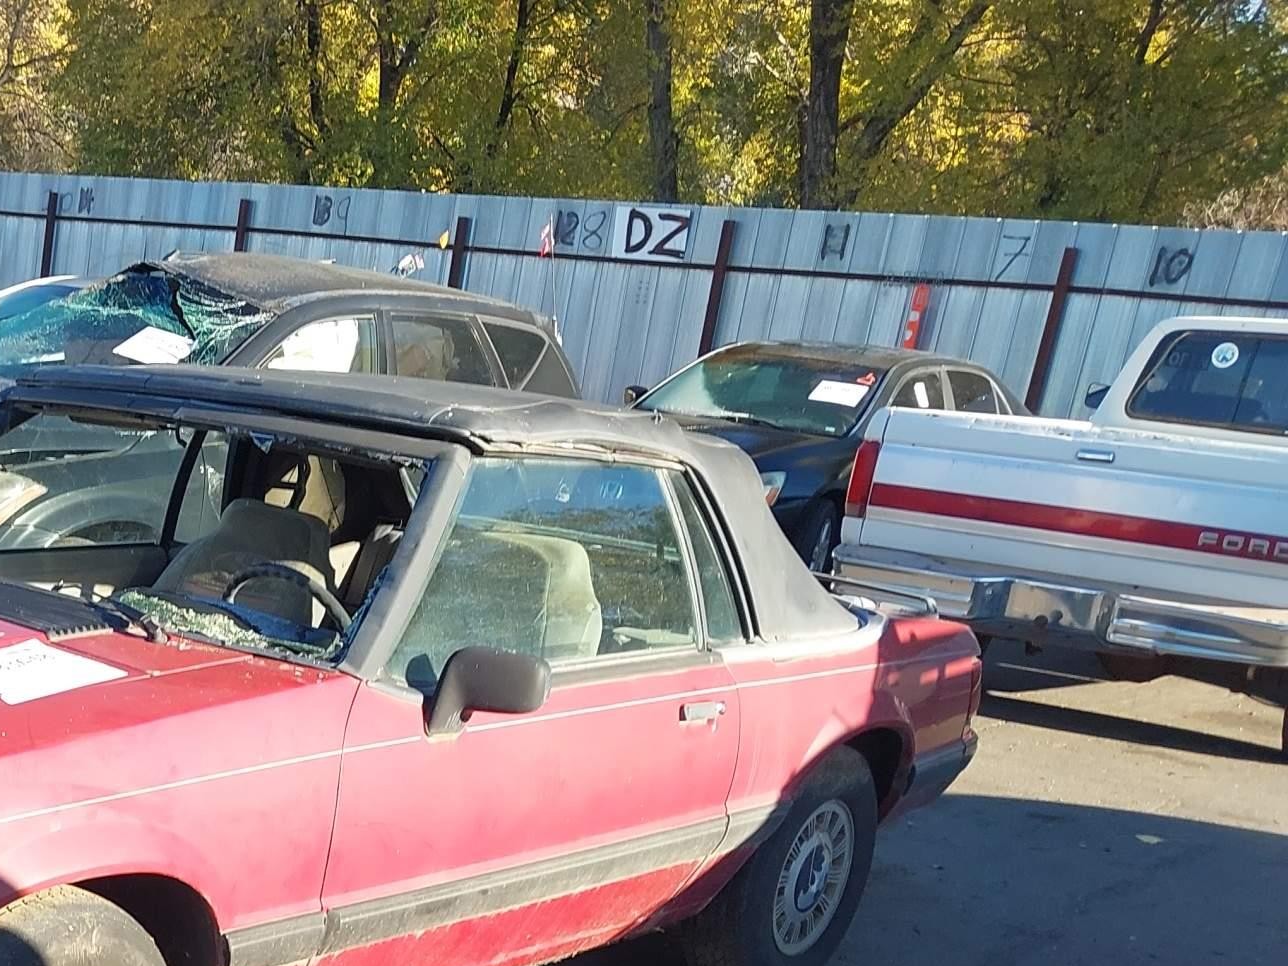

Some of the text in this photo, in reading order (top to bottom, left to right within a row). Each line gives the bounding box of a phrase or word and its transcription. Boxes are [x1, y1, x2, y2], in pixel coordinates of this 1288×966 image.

[624, 208, 690, 260] DZ
[995, 234, 1031, 281] 7
[1148, 246, 1194, 288] 10
